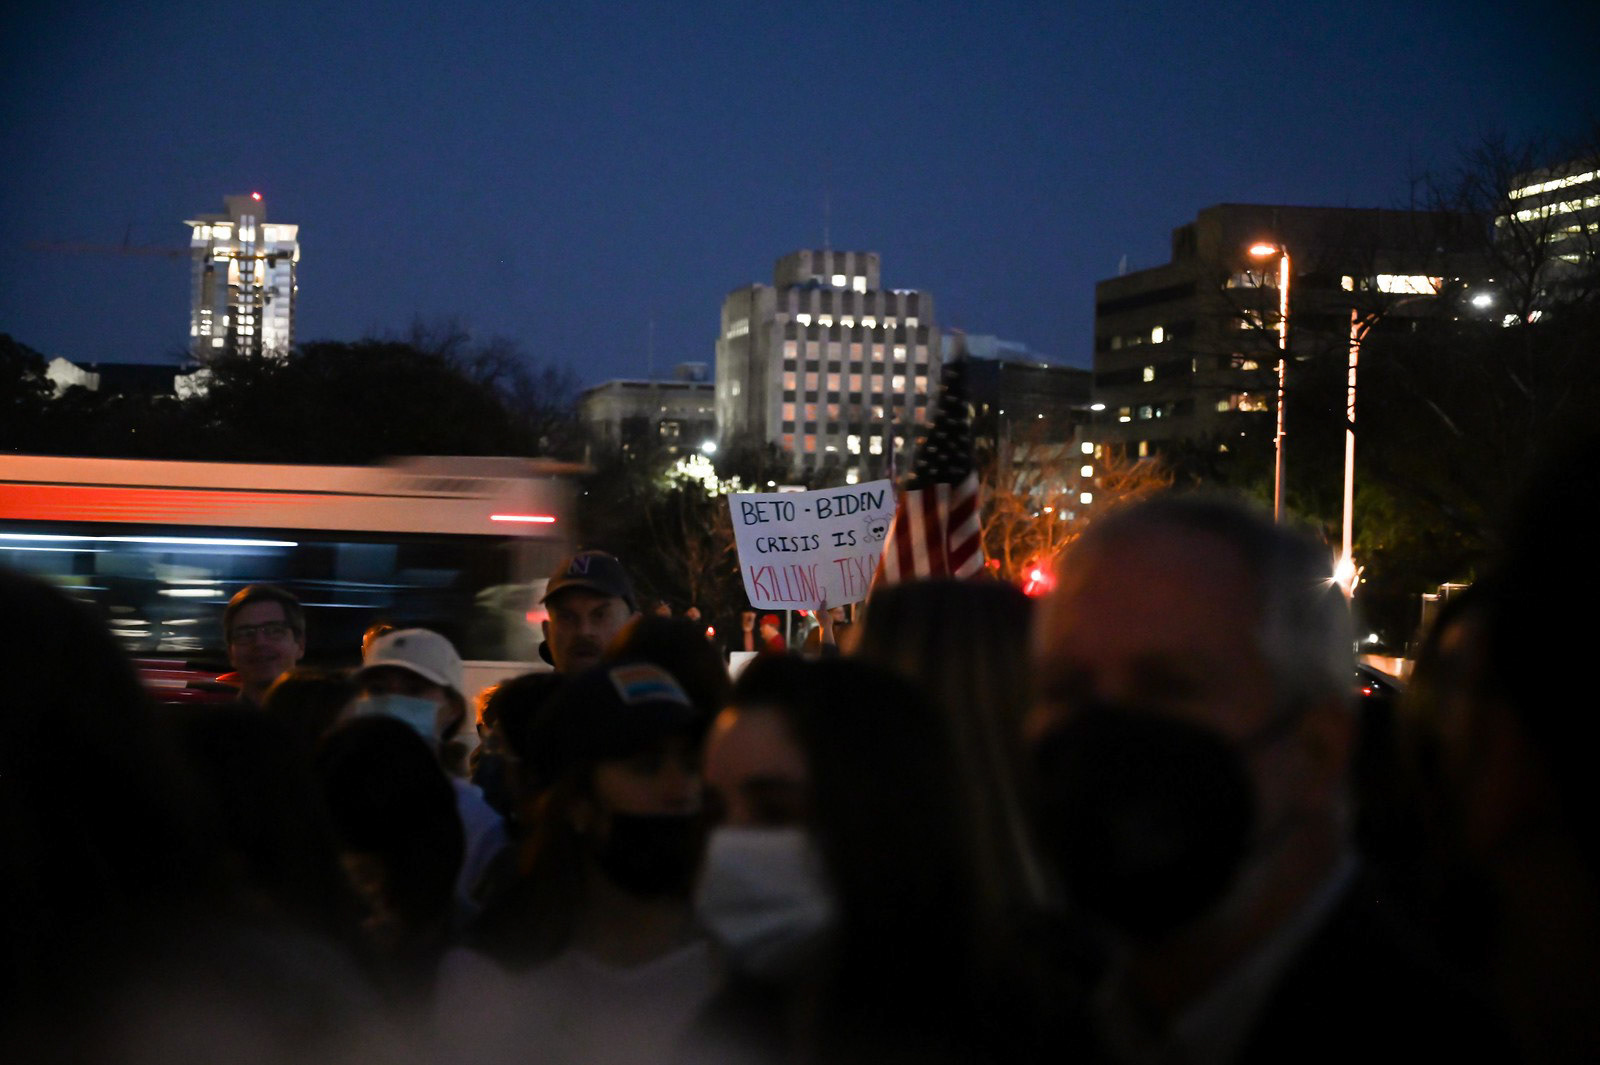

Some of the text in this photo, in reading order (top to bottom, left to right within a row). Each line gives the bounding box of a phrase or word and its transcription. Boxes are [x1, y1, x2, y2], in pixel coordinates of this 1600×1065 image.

[741, 501, 796, 526] BETO
[816, 489, 885, 519] BIDEN
[755, 530, 857, 554] CRISIS IS
[750, 563, 828, 603] KILLING
